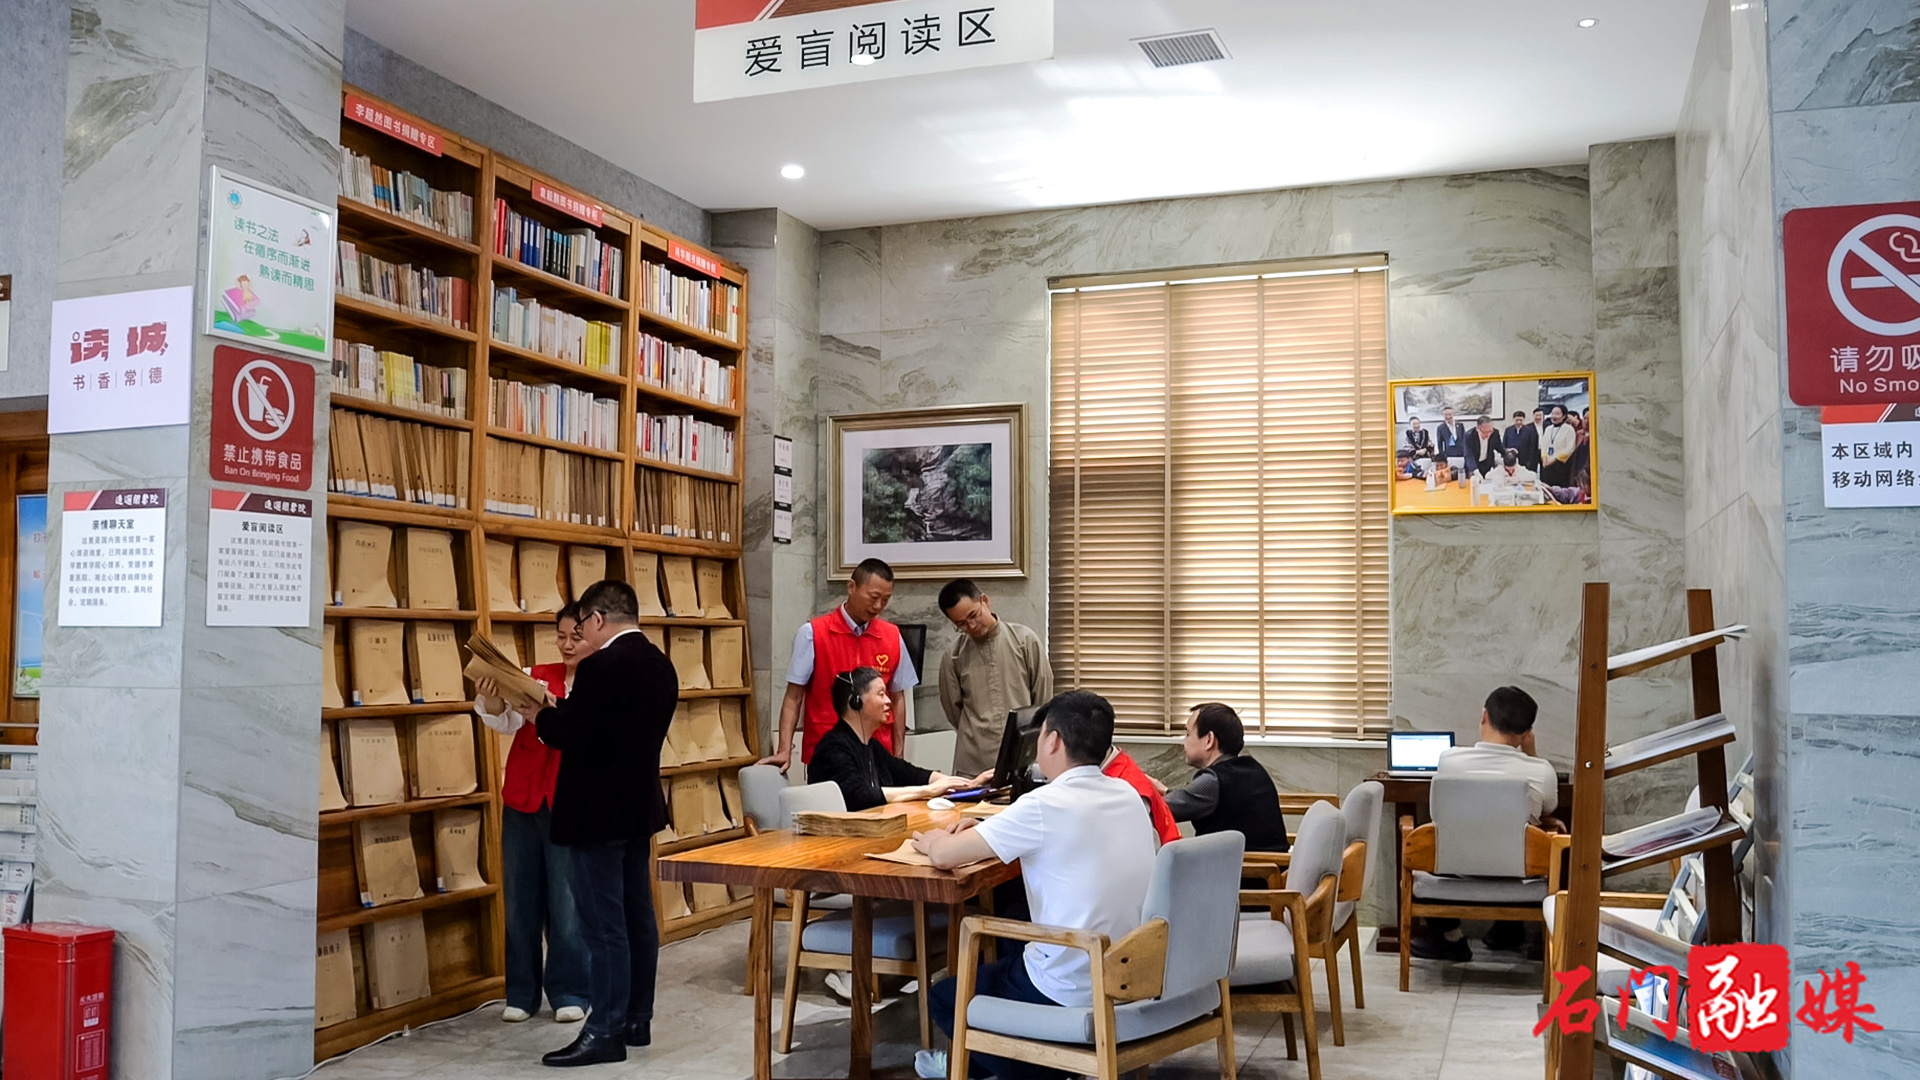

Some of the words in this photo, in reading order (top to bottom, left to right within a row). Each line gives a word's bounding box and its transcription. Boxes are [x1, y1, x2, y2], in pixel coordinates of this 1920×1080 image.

[744, 7, 996, 77] 爱盲阅读区
[233, 216, 279, 243] 读书之法
[243, 240, 311, 272] 在循序而渐进
[259, 264, 315, 292] 熟读而精思
[1839, 378, 1868, 394] No
[1873, 377, 1920, 392] Smo
[223, 443, 302, 471] 禁止携带食品
[1831, 441, 1913, 460] 本区域内
[224, 465, 238, 475] Ban
[239, 467, 250, 477] On
[252, 469, 281, 483] Bringing
[282, 473, 300, 483] Food
[1832, 469, 1920, 488] 移动网络
[92, 519, 135, 530] 亲情聊天室
[241, 521, 284, 535] 爱盲阅读区
